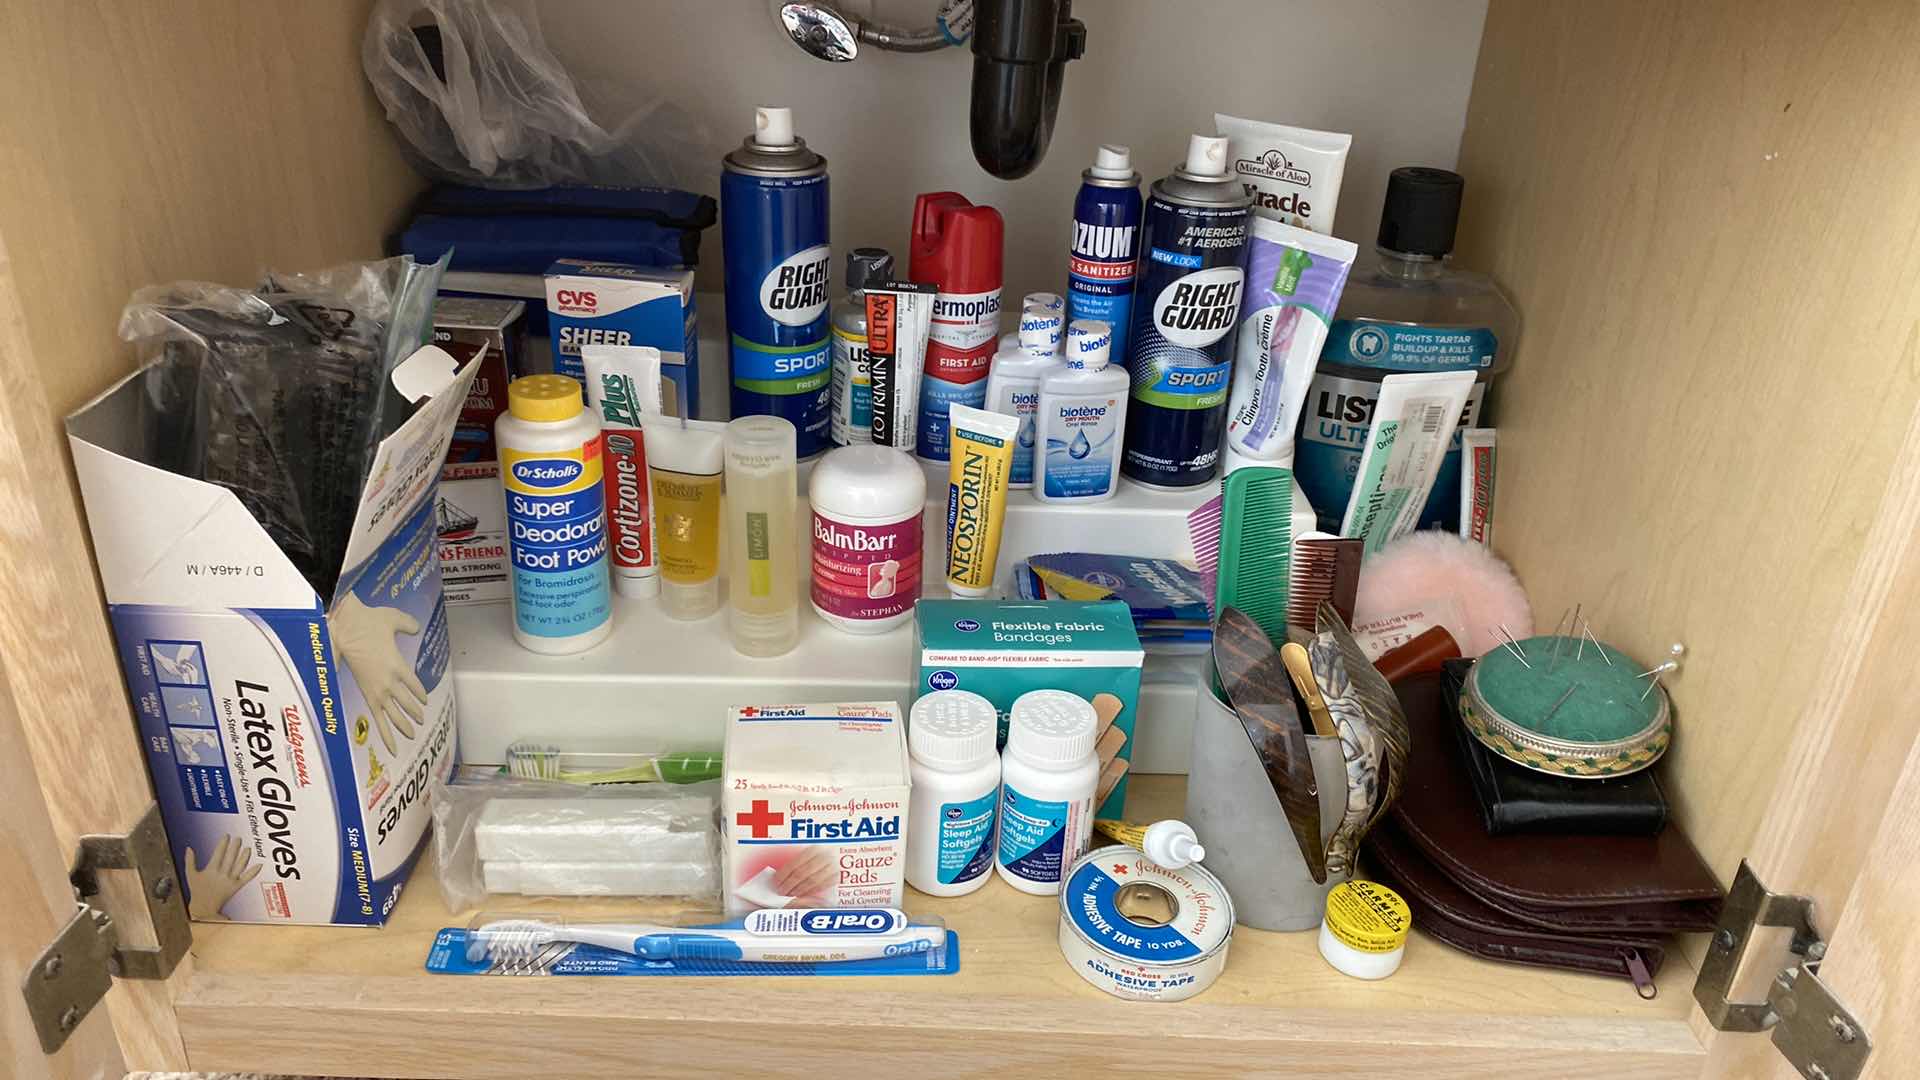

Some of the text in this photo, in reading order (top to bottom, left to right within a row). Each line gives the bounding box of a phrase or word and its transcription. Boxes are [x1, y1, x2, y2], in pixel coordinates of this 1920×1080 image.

[1239, 162, 1308, 184] Miracle of Aloe
[1185, 226, 1245, 238] AMERICA'S
[1177, 236, 1192, 248] #1
[1152, 250, 1200, 266] NEW LOOK
[777, 257, 830, 287] RIGHT
[1077, 263, 1134, 277] SANITIZER
[769, 282, 830, 310] GUARD
[1074, 282, 1113, 295] ORIGINAL
[1172, 280, 1241, 307] RIGHT
[556, 289, 598, 308] CVS
[558, 306, 597, 315] pharmacy
[932, 295, 1001, 325] ermoplas
[1161, 305, 1237, 331] GUARD
[872, 297, 889, 352] ULTRA
[559, 326, 632, 347] SHEER
[1394, 333, 1472, 344] FIGHTS TARTAR
[1392, 343, 1439, 354] BUILDUP
[1447, 345, 1474, 354] KILLS
[774, 350, 830, 373] SPORT
[939, 356, 987, 369] FIRST AID
[1422, 355, 1437, 364] OF
[1437, 355, 1471, 364] GERMS
[1168, 369, 1225, 387] SPORT
[1241, 387, 1261, 427] Clinpro
[1254, 350, 1272, 382] Tooth
[600, 373, 633, 429] Plus
[872, 356, 888, 441] LOTRIMIN
[1060, 404, 1107, 419] biotène
[1064, 415, 1101, 424] DRY MOUTH
[1065, 420, 1079, 428] Oral
[1381, 423, 1399, 437] The
[513, 496, 575, 520] Super
[949, 487, 958, 527] OINTMENT
[951, 450, 985, 584] NEOSPORIN
[814, 516, 898, 552] BalmBarr
[456, 545, 506, 561] FRIEND
[516, 547, 561, 569] Foot
[186, 564, 264, 577] D 446A M
[461, 563, 503, 574] STRONG
[859, 603, 905, 618] STEPHAN
[991, 621, 1105, 632] Flexible Fabric
[993, 632, 1073, 645] Bandages
[308, 622, 337, 736] Medical Exam Quality
[931, 674, 957, 689] Kroger
[759, 709, 806, 718] First Aid
[872, 710, 893, 718] Pads
[283, 703, 313, 790] Walgreens
[222, 697, 266, 859] Non-Sterile Single-Use Fits Either Hand
[235, 679, 302, 881] Latex Gloves
[734, 778, 749, 791] 25
[376, 767, 431, 846] Gloves
[789, 799, 900, 818] Johnson Johnson
[790, 815, 901, 839] First Aid
[943, 821, 990, 841] Sleep Aid
[1003, 811, 1025, 832] Sleep
[1026, 824, 1045, 837] Aid
[347, 826, 360, 849] Size
[942, 835, 983, 849] Softgels
[839, 870, 878, 885] Pads
[838, 888, 892, 898] For Cleansing
[838, 896, 892, 907] And Covering
[1359, 882, 1405, 924] CARMEX
[810, 913, 887, 931] Oral-B
[1083, 892, 1114, 936] ADHESIVE
[1112, 930, 1143, 950] TAPE
[1146, 941, 1159, 950] 10
[1162, 939, 1186, 950] YDS.
[1193, 891, 1217, 937] Johnson
[1086, 959, 1196, 989] ADHESIVE TAPE
[1120, 968, 1162, 980] RED CROSS
